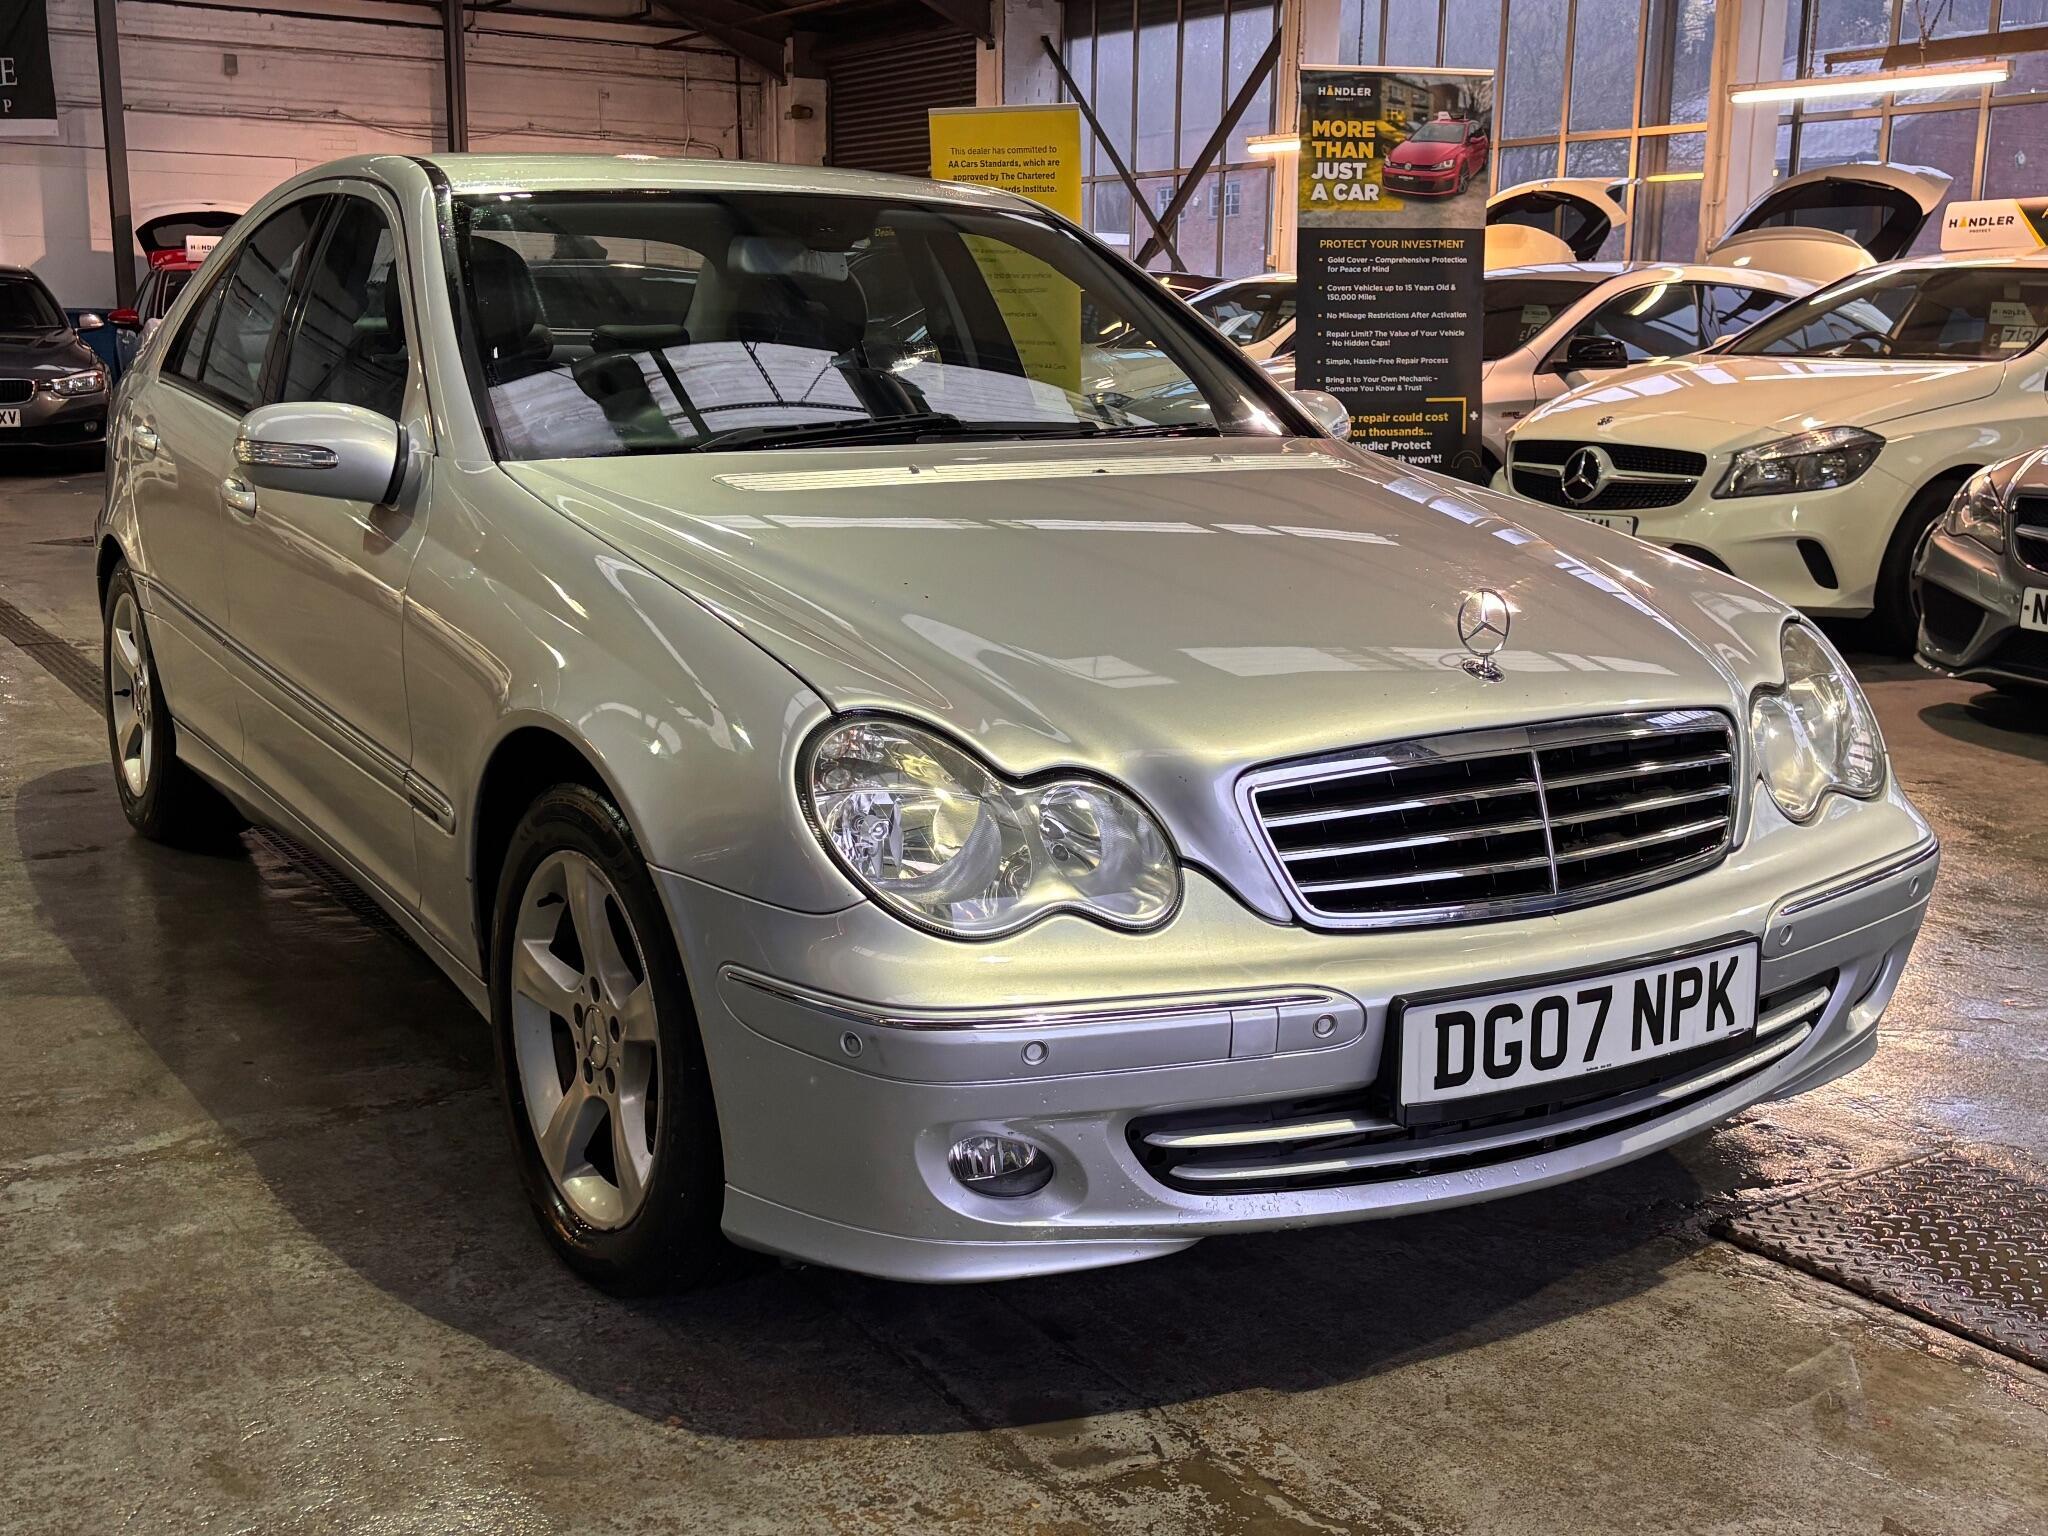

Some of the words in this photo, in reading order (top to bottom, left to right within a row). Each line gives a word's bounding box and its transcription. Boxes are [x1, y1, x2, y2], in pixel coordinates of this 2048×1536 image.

[1313, 120, 1375, 137] MORE
[951, 147, 966, 155] This
[968, 147, 991, 155] dealer
[1007, 146, 1048, 154] committed
[1312, 141, 1374, 158] THAN
[948, 160, 959, 168] AA
[961, 160, 978, 168] Cars
[979, 159, 1021, 168] Standards,
[1023, 159, 1045, 167] which
[1311, 162, 1367, 179] JUST
[953, 173, 989, 181] approved
[990, 173, 999, 181] by
[1001, 172, 1015, 180] The
[1017, 172, 1055, 180] Chartered
[1022, 185, 1057, 193] Institute.
[1311, 183, 1328, 200] A
[1333, 183, 1379, 200] CAR
[1320, 240, 1367, 248] PROTECT
[1370, 240, 1399, 248] YOUR
[1401, 240, 1464, 248] INVESTMENT
[1375, 256, 1430, 265] Comprehensive
[1338, 312, 1366, 320] Mileage
[1368, 311, 1409, 319] Restrictions
[1411, 311, 1429, 319] After
[1325, 376, 1344, 384] Bring
[1359, 413, 1390, 424] repair
[1393, 413, 1423, 422] could
[1425, 412, 1449, 421] cost
[1369, 427, 1433, 437] thousands...
[1391, 441, 1431, 450] Protect
[1408, 454, 1442, 464] won't!
[1434, 985, 1613, 1090] DG07
[1632, 956, 1738, 1051] NPK
